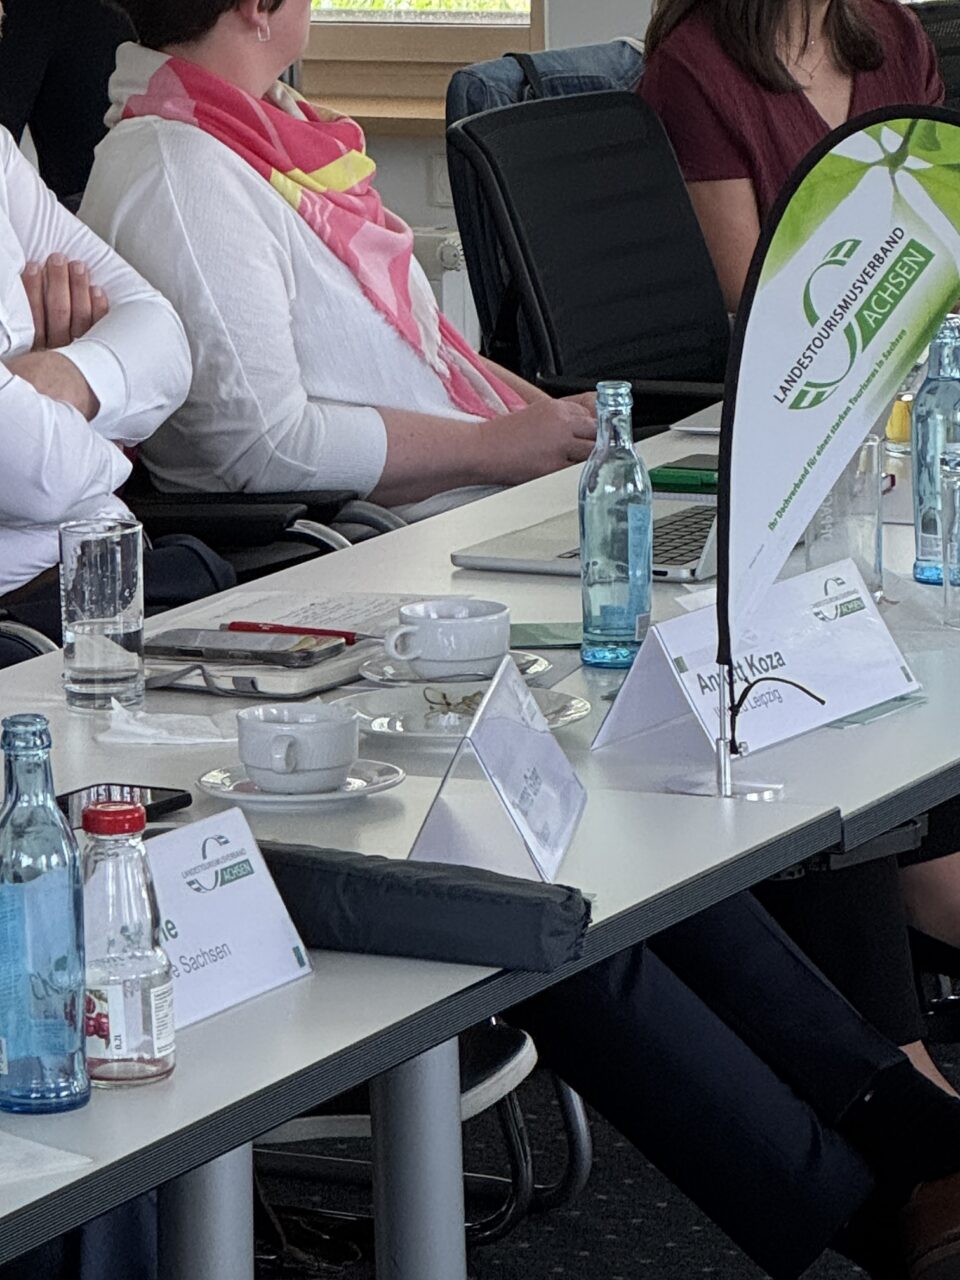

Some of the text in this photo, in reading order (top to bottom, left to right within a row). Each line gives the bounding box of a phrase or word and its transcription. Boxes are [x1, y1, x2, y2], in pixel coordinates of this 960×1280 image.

[772, 225, 905, 403] LANDESTOURISMUSVERBAND
[767, 516, 778, 530] Ihr
[774, 466, 810, 518] Dachverband
[805, 454, 818, 469] für
[814, 433, 832, 456] einen
[828, 404, 851, 434] starken
[848, 366, 878, 406] Tourismus
[880, 327, 906, 360] Sachsen
[744, 651, 787, 678] Koza
[746, 686, 784, 711] Leipzig
[178, 942, 233, 974] Sachsen
